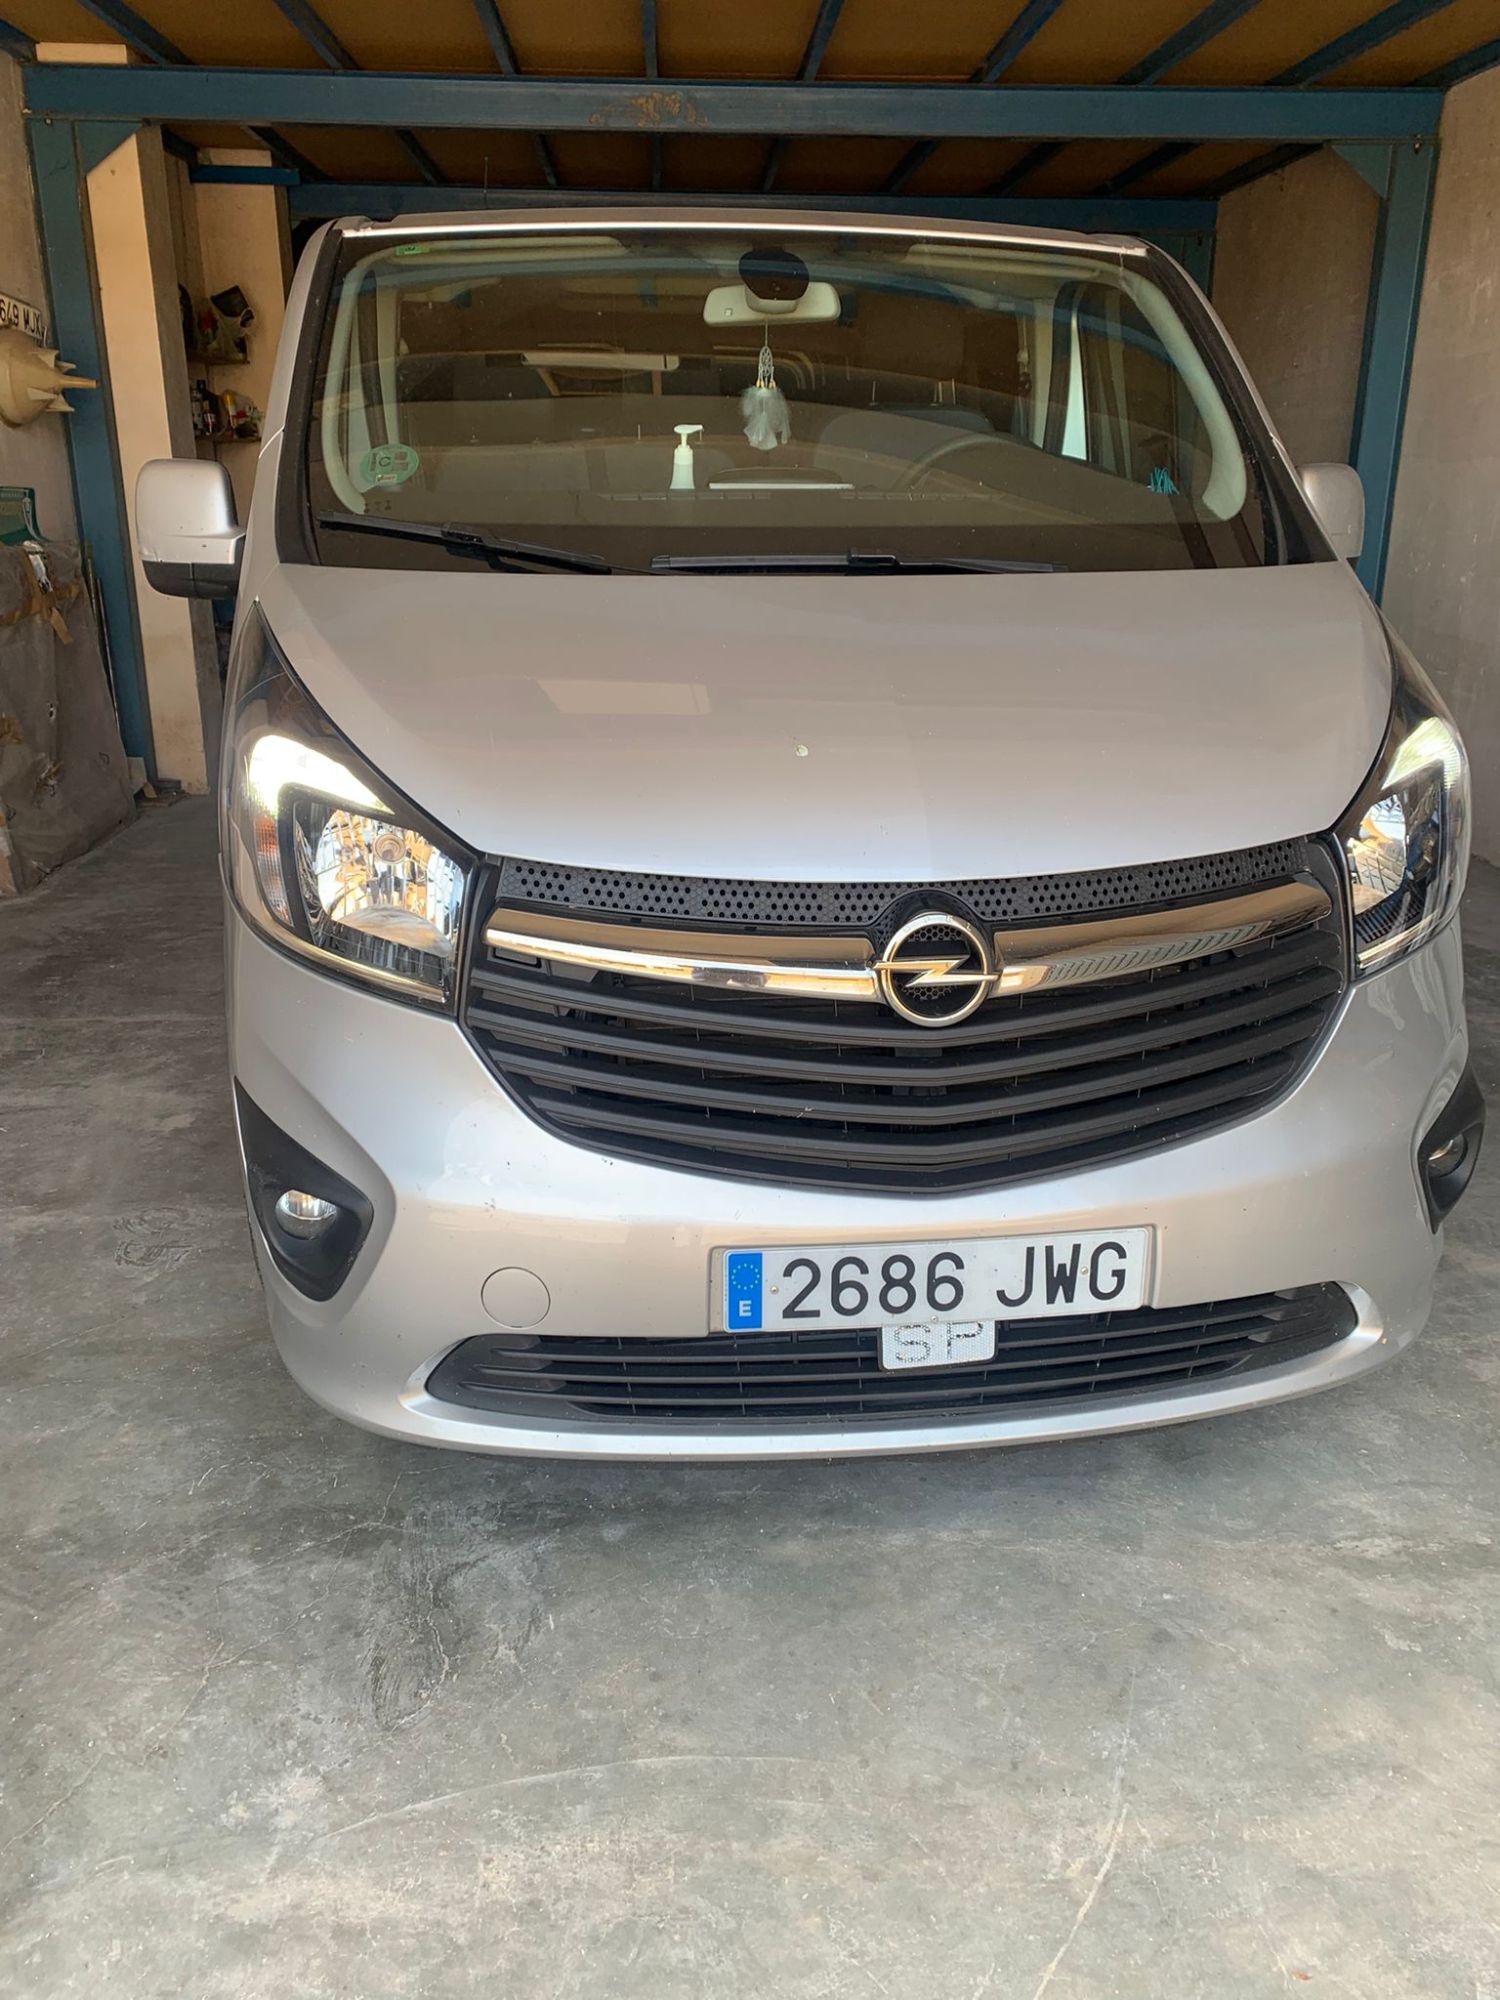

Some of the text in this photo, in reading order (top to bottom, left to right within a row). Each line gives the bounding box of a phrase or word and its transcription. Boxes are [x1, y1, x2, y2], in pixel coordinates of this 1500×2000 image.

[782, 1241, 1127, 1319] 2686 JWG
[738, 1300, 752, 1317] E
